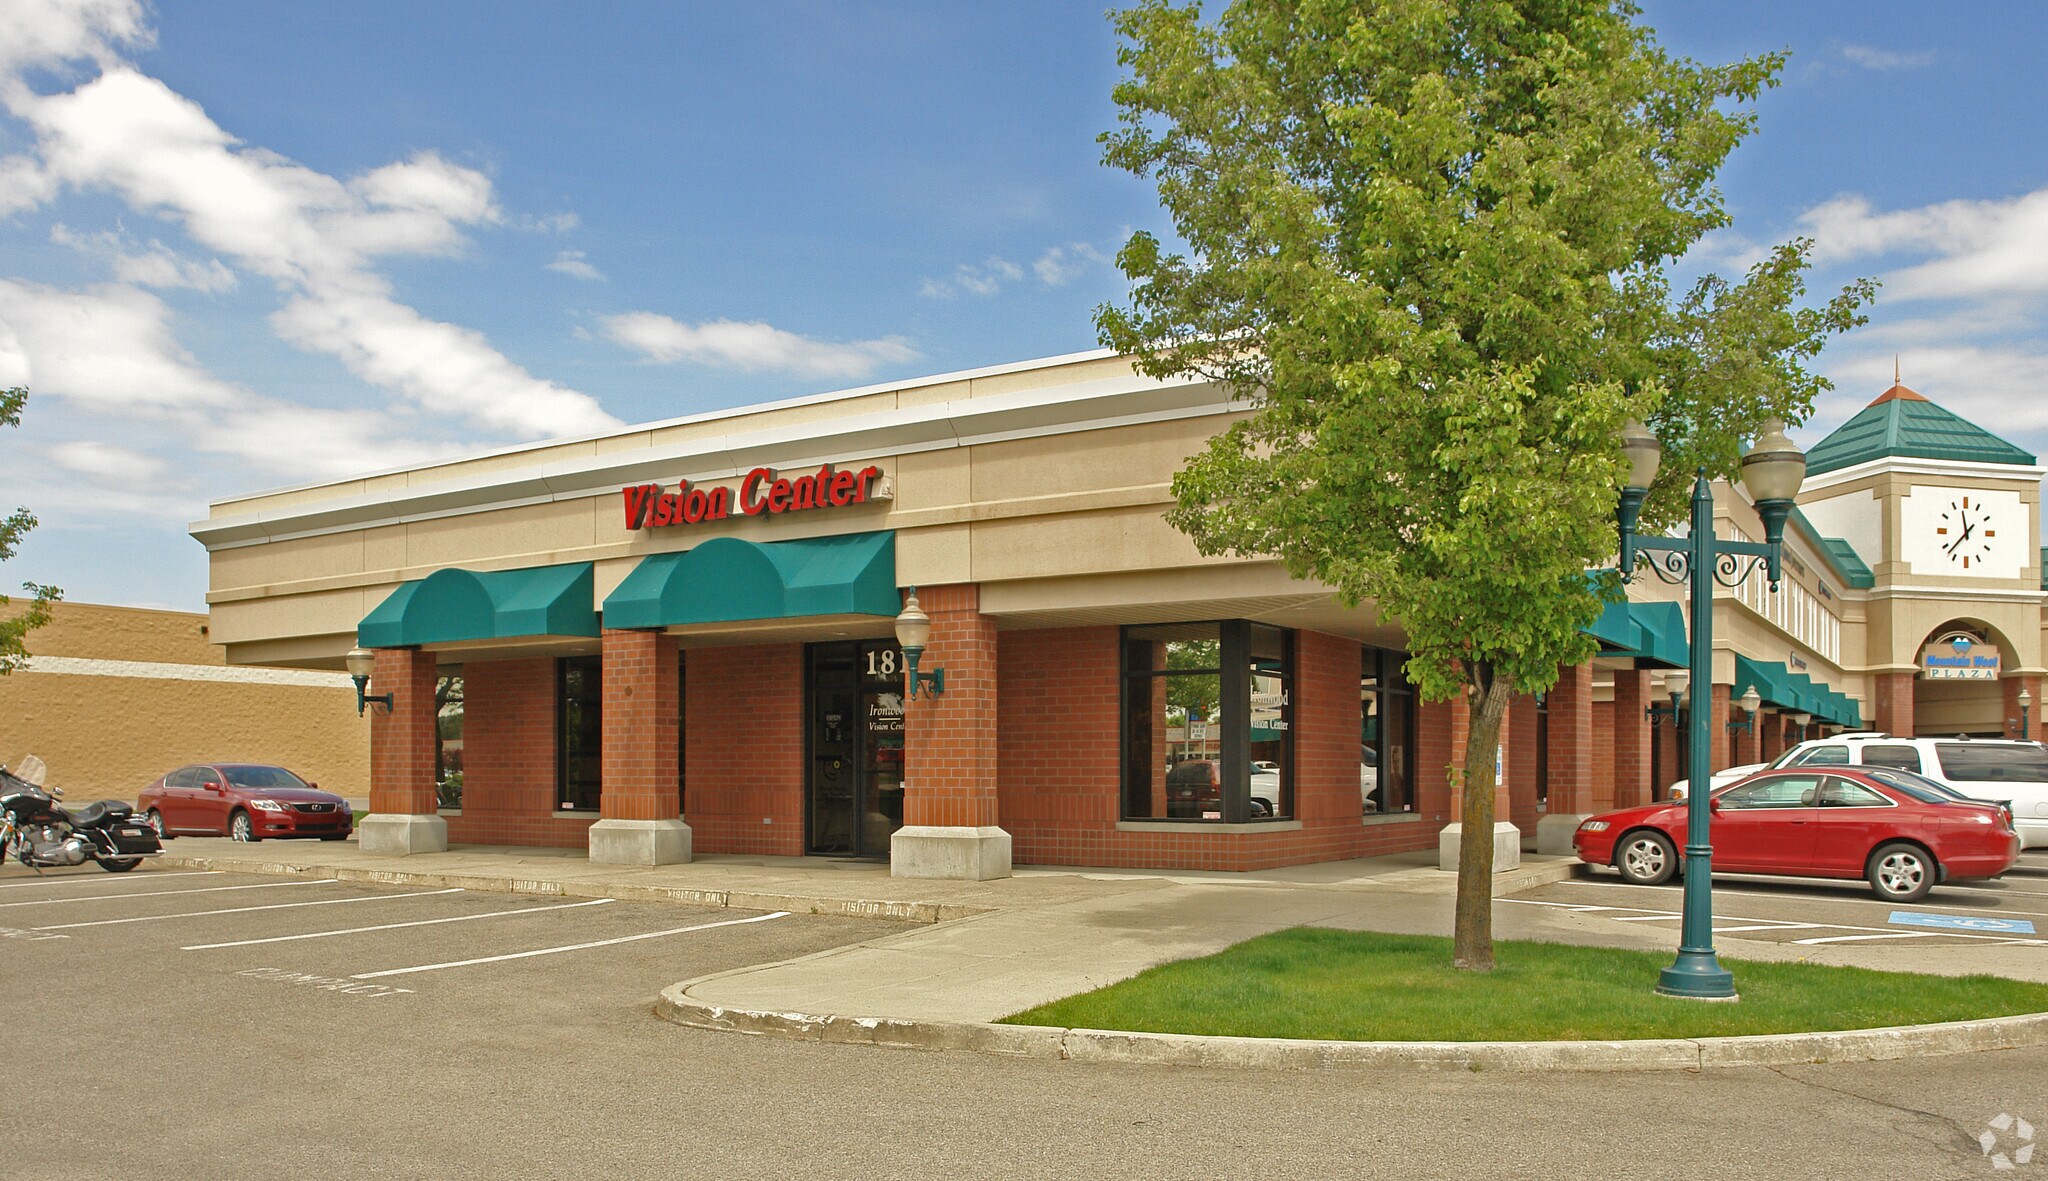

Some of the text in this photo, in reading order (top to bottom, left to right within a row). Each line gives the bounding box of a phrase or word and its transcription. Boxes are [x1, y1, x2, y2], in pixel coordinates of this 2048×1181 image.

[622, 463, 882, 531] Vision Center
[1926, 655, 1998, 668] Mountain West
[1931, 668, 1993, 679] PLAZA
[869, 704, 905, 716] Ironwoo
[869, 721, 905, 731] Vision Cent
[1269, 718, 1289, 731] Center
[841, 901, 912, 918] VISITOR ONLY
